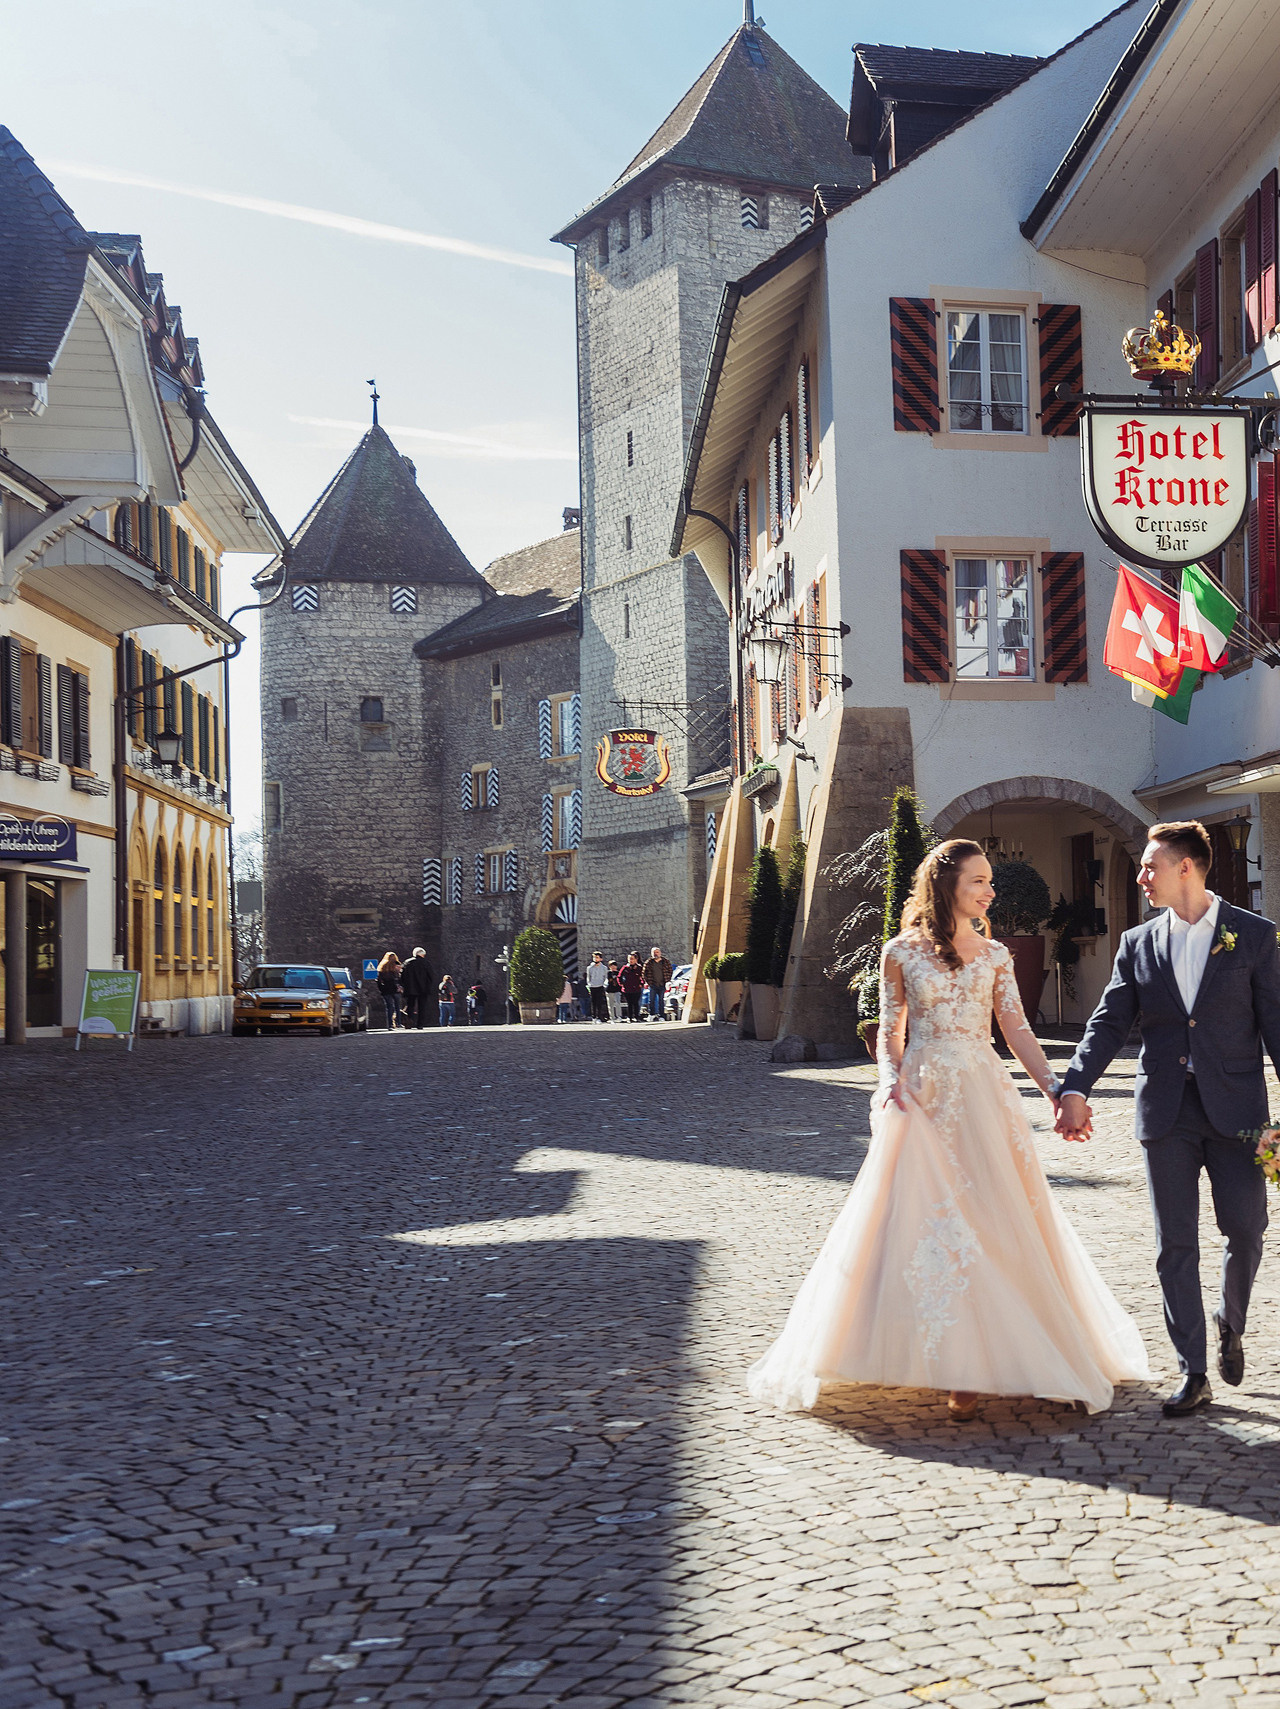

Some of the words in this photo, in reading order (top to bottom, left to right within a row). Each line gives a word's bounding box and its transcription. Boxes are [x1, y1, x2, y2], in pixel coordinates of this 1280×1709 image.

[1114, 419, 1225, 466] Hotel
[1111, 465, 1229, 510] Krone
[1135, 516, 1208, 532] Terrasse
[1155, 534, 1189, 553] Bar
[34, 824, 59, 835] Uhren
